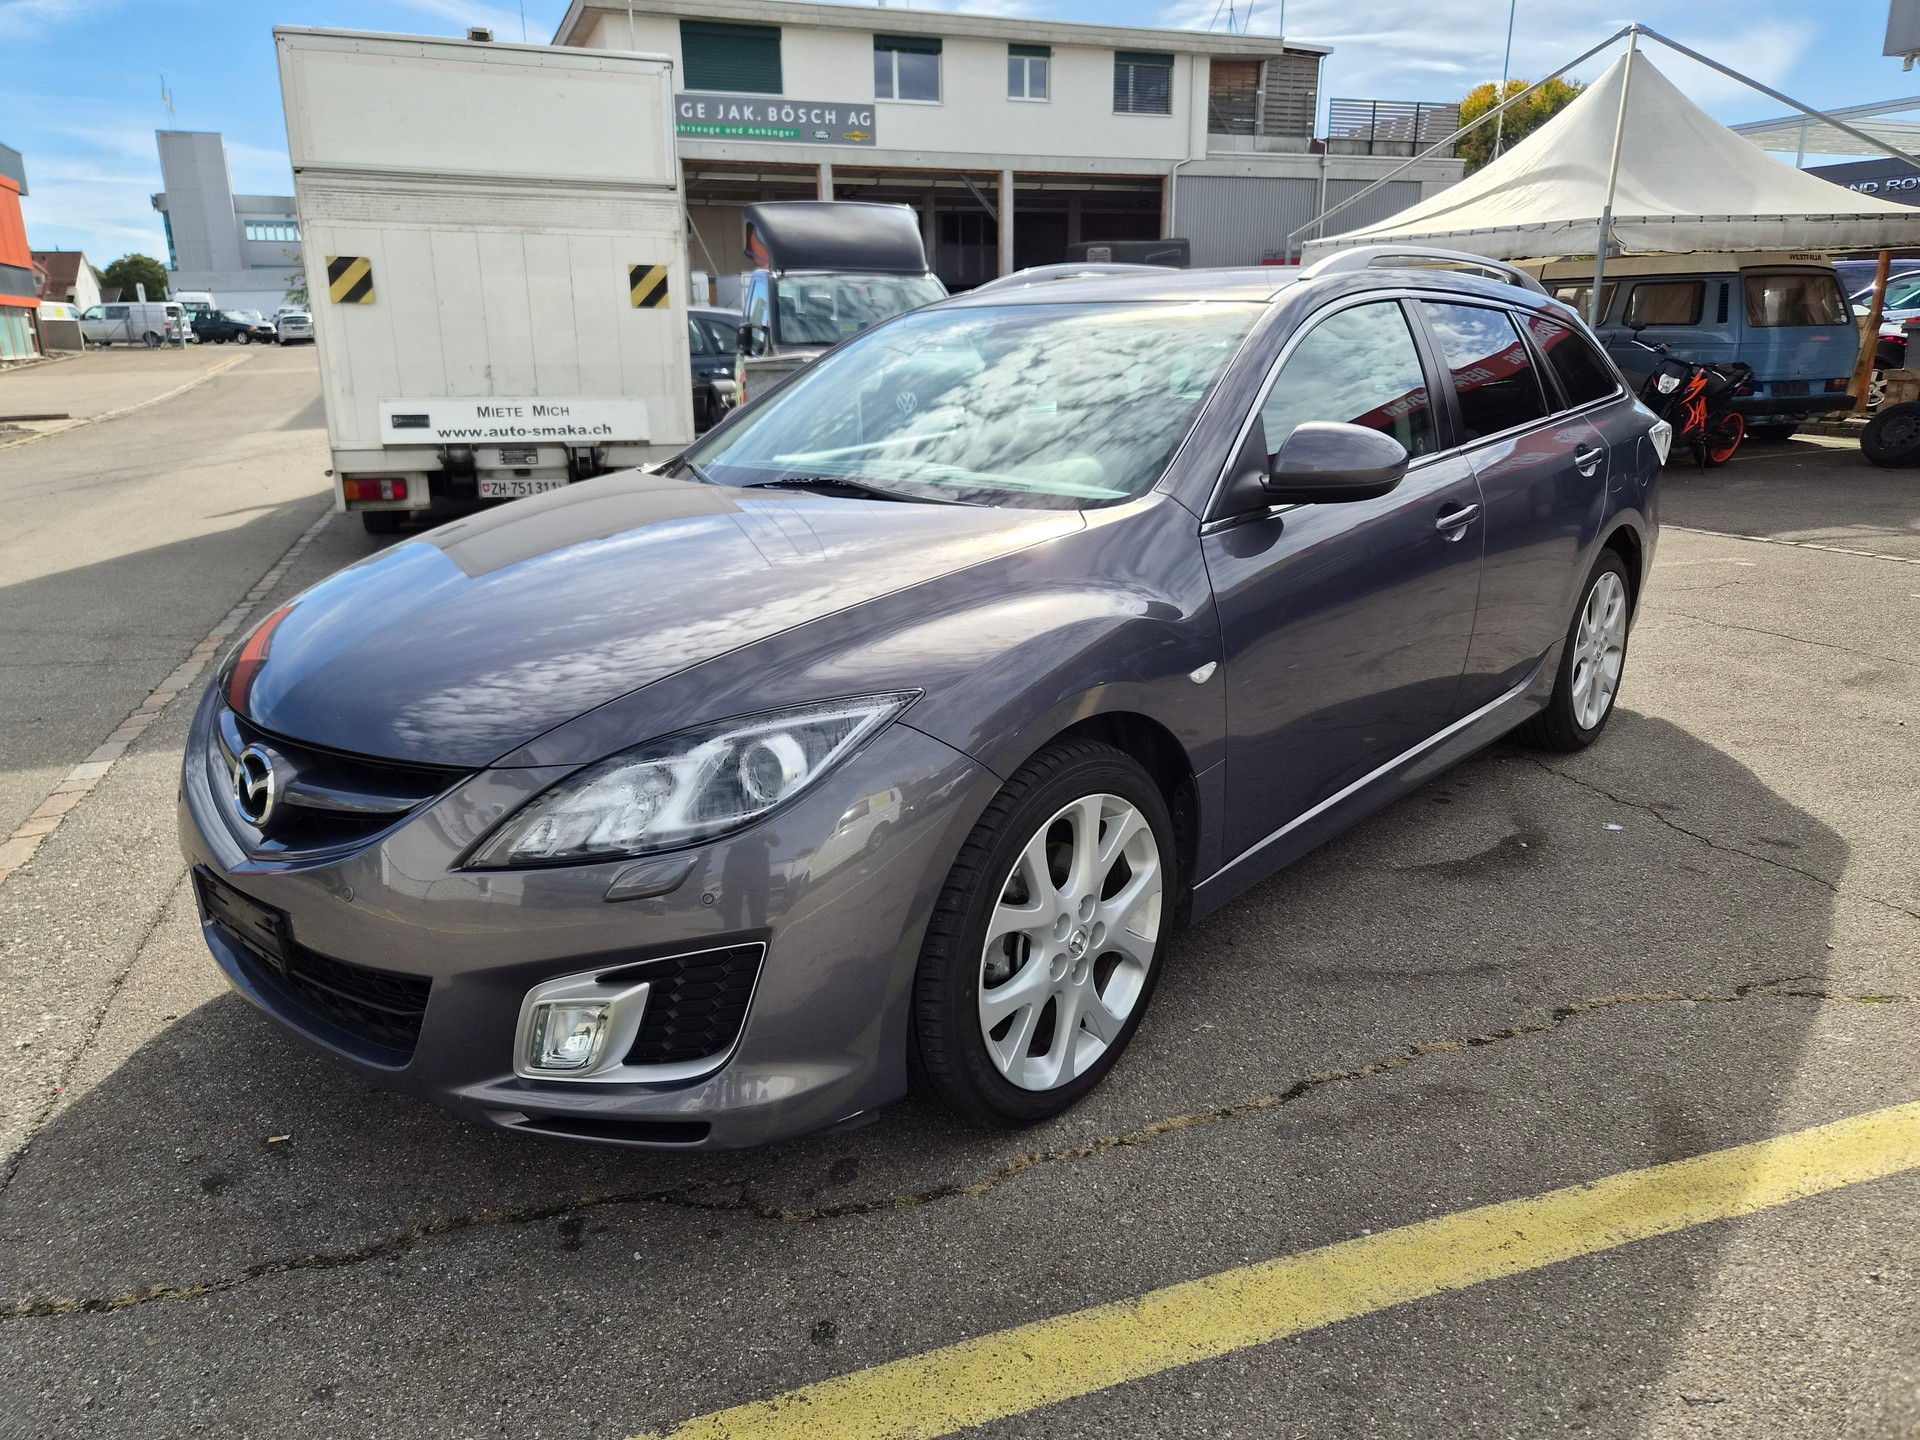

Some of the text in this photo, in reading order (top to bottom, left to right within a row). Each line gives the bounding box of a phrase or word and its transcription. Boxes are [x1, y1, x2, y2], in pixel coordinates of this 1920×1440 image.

[680, 102, 871, 126] GE JAK. BÖSCH AG
[725, 127, 743, 135] und
[748, 128, 795, 137] Anhänger
[1848, 182, 1879, 194] ND
[437, 423, 613, 438] www.auto-smaka.ch
